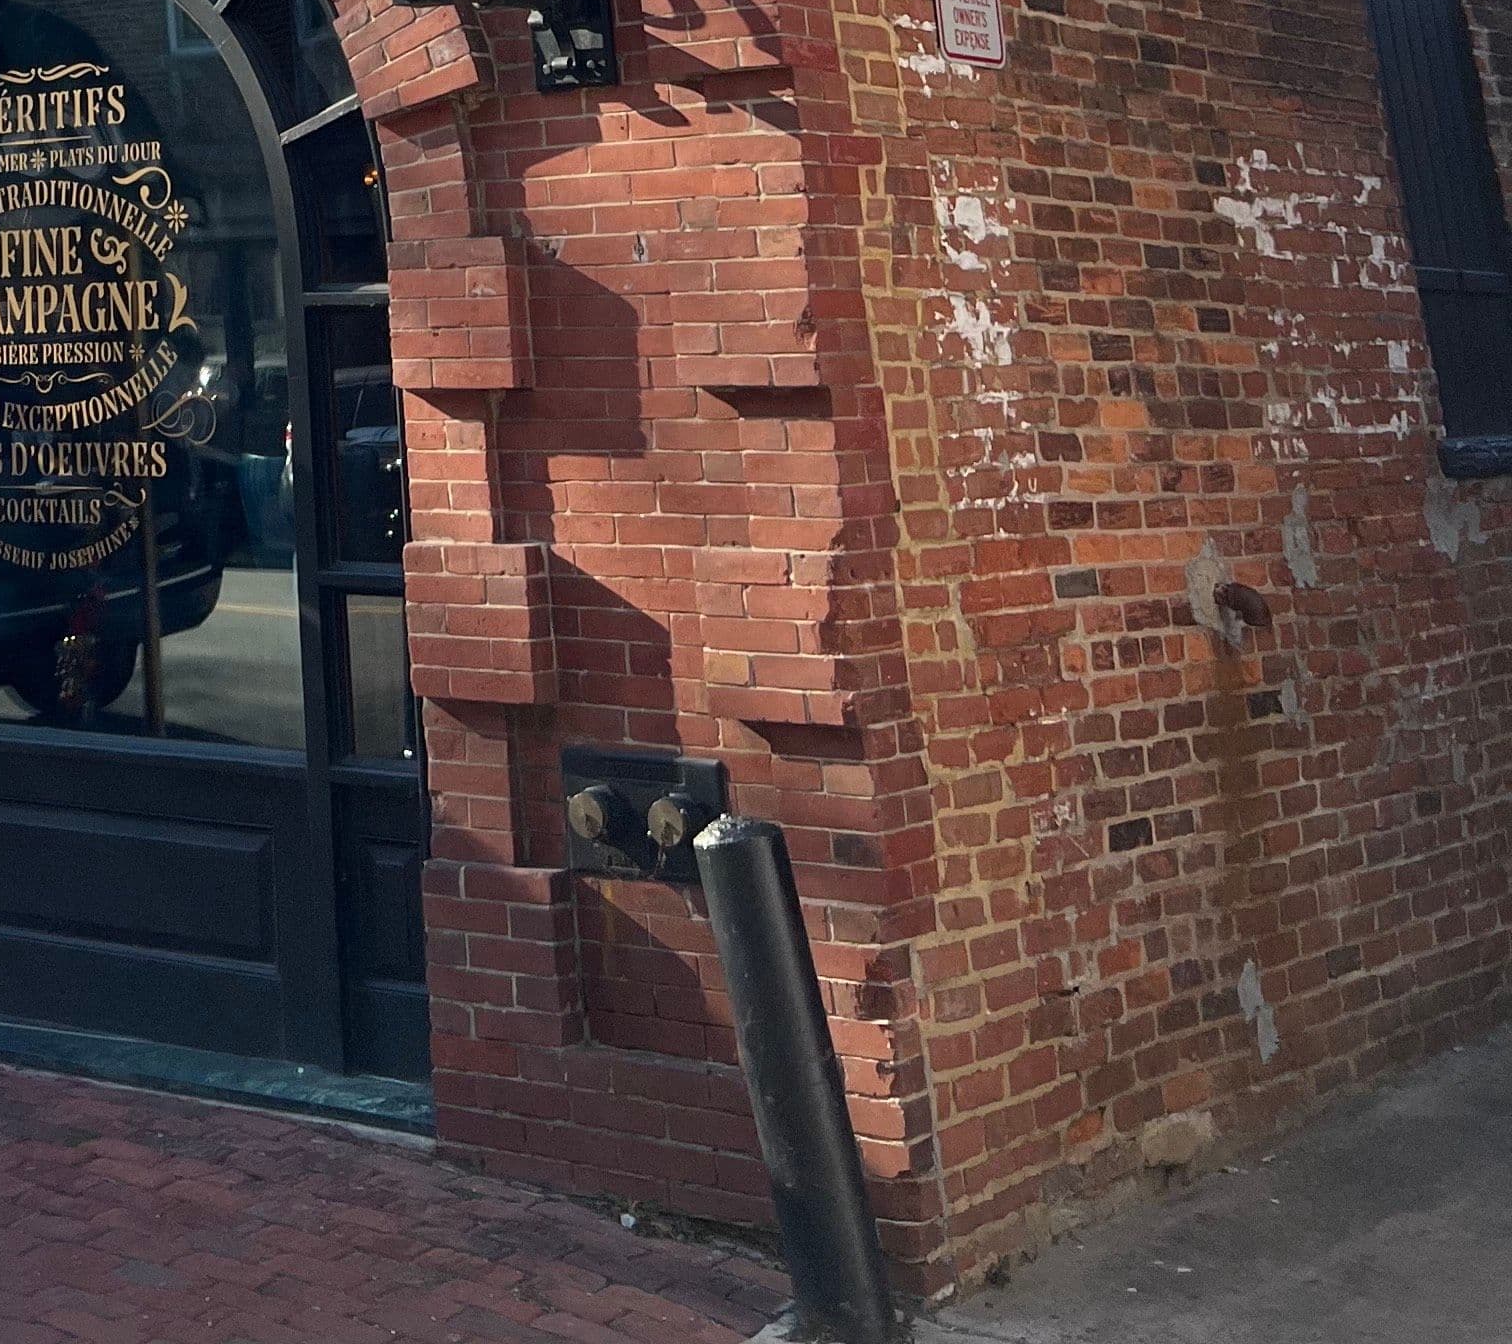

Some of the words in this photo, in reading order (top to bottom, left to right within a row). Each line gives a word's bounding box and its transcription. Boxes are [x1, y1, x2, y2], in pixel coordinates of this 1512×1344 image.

[954, 28, 991, 51] EXPENSE
[50, 146, 94, 169] PLATS
[97, 144, 118, 165] DU
[121, 140, 161, 163] JOUR
[0, 226, 83, 279] FINE
[42, 341, 124, 365] PRESSION
[2, 339, 179, 432] EXCEPTIONNELLE
[11, 440, 167, 478] D'OEUVRES
[49, 521, 132, 570] JOSEPHINE
